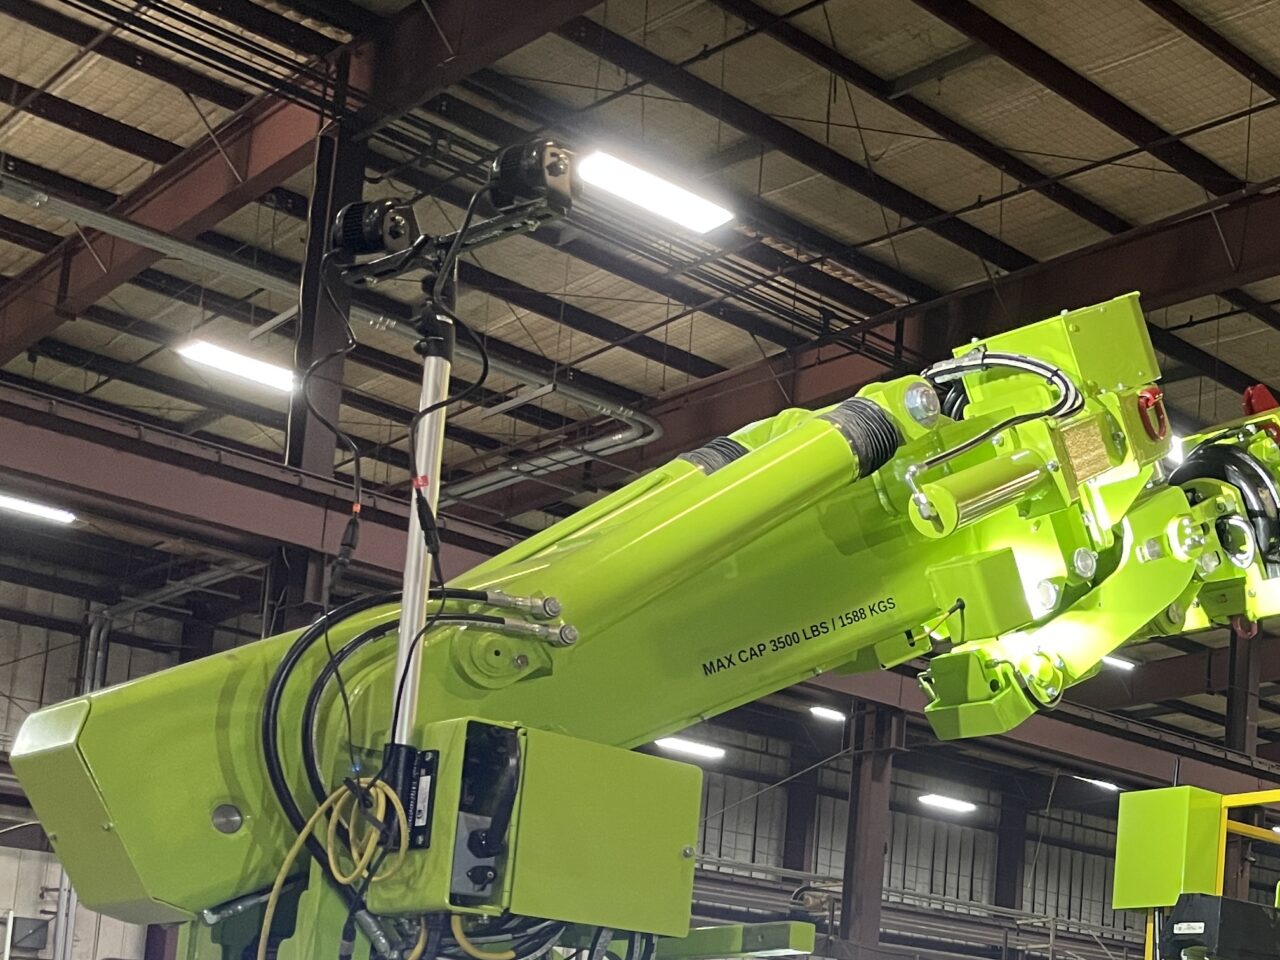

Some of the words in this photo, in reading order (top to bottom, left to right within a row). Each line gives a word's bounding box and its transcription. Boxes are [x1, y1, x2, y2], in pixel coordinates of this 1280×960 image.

[702, 654, 736, 676] MAX
[738, 643, 766, 663] CAP
[769, 632, 800, 652] 3500
[802, 622, 829, 640] LBS
[831, 618, 836, 631] /
[838, 608, 867, 628] 1588
[868, 597, 896, 617] KGS
